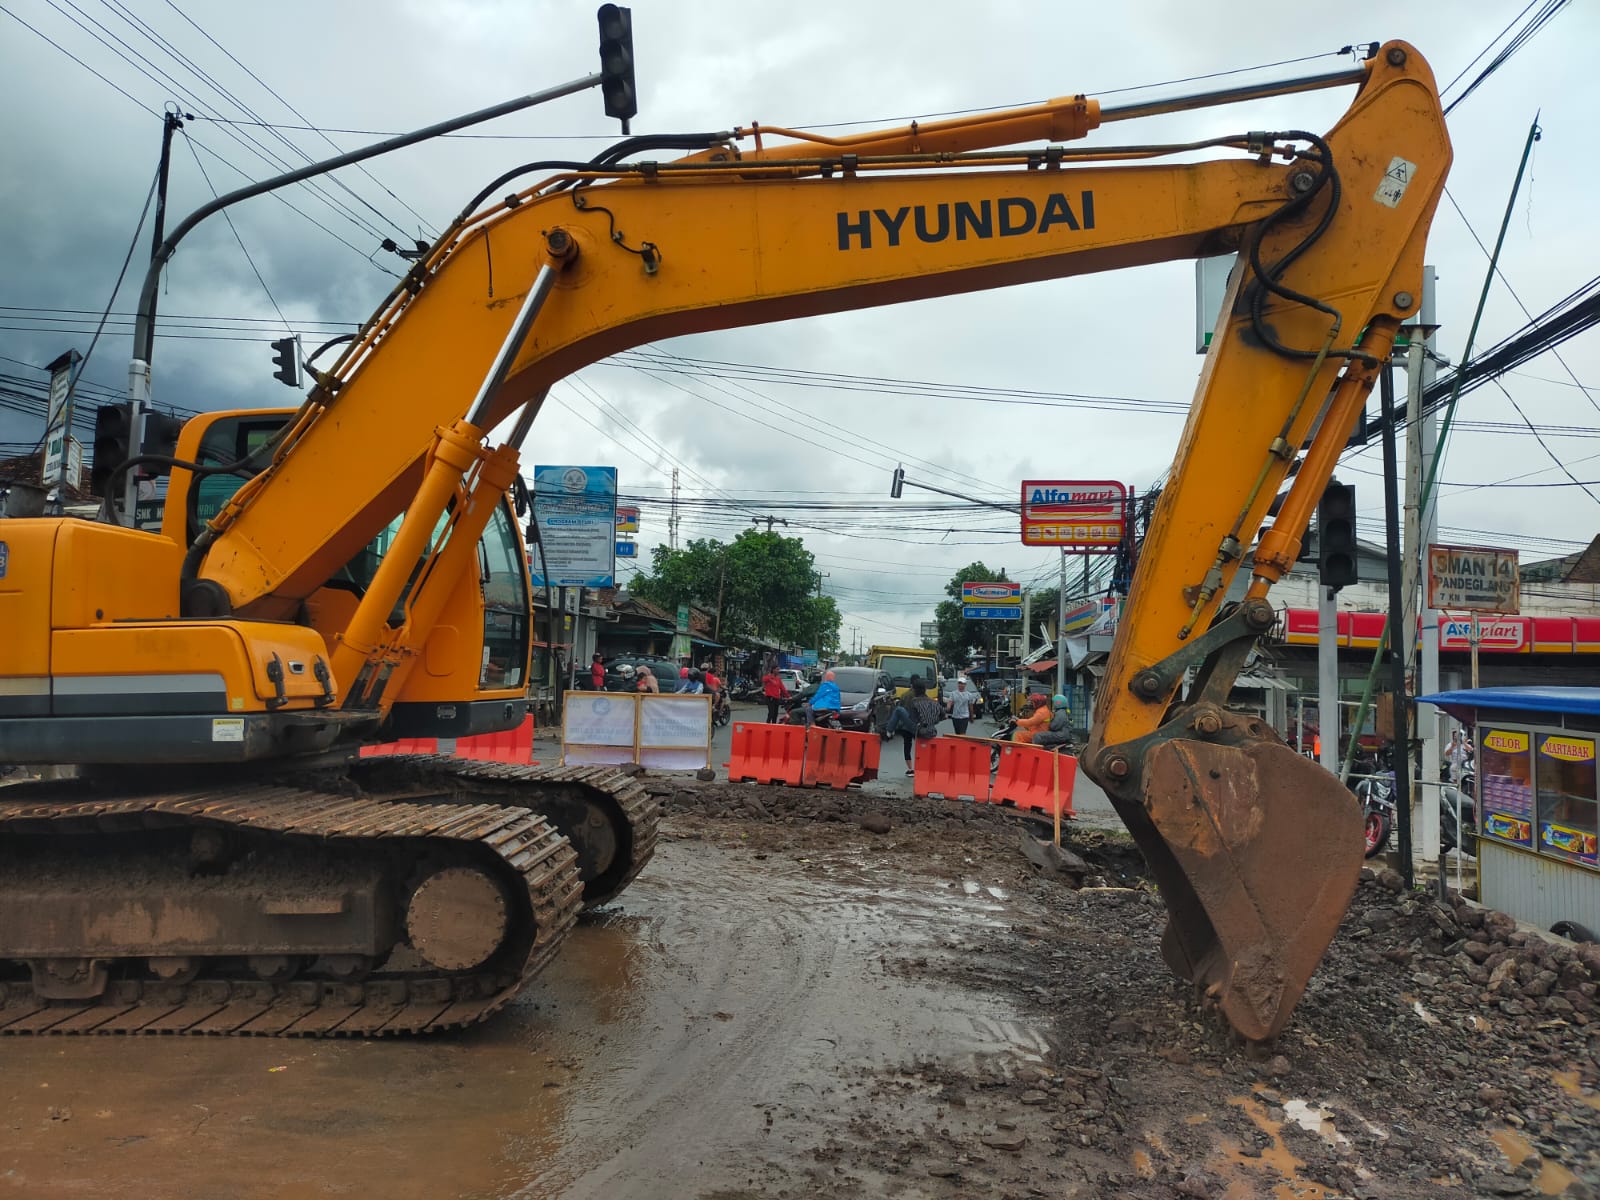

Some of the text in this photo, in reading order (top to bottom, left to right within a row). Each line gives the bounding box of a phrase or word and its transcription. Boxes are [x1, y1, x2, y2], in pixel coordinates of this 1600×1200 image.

[836, 190, 1095, 251] HYUNDAI
[1437, 555, 1510, 578] SMAN 14
[1439, 592, 1445, 601] 7
[1489, 736, 1521, 750] TELOR
[1545, 742, 1590, 758] MARTABAK
